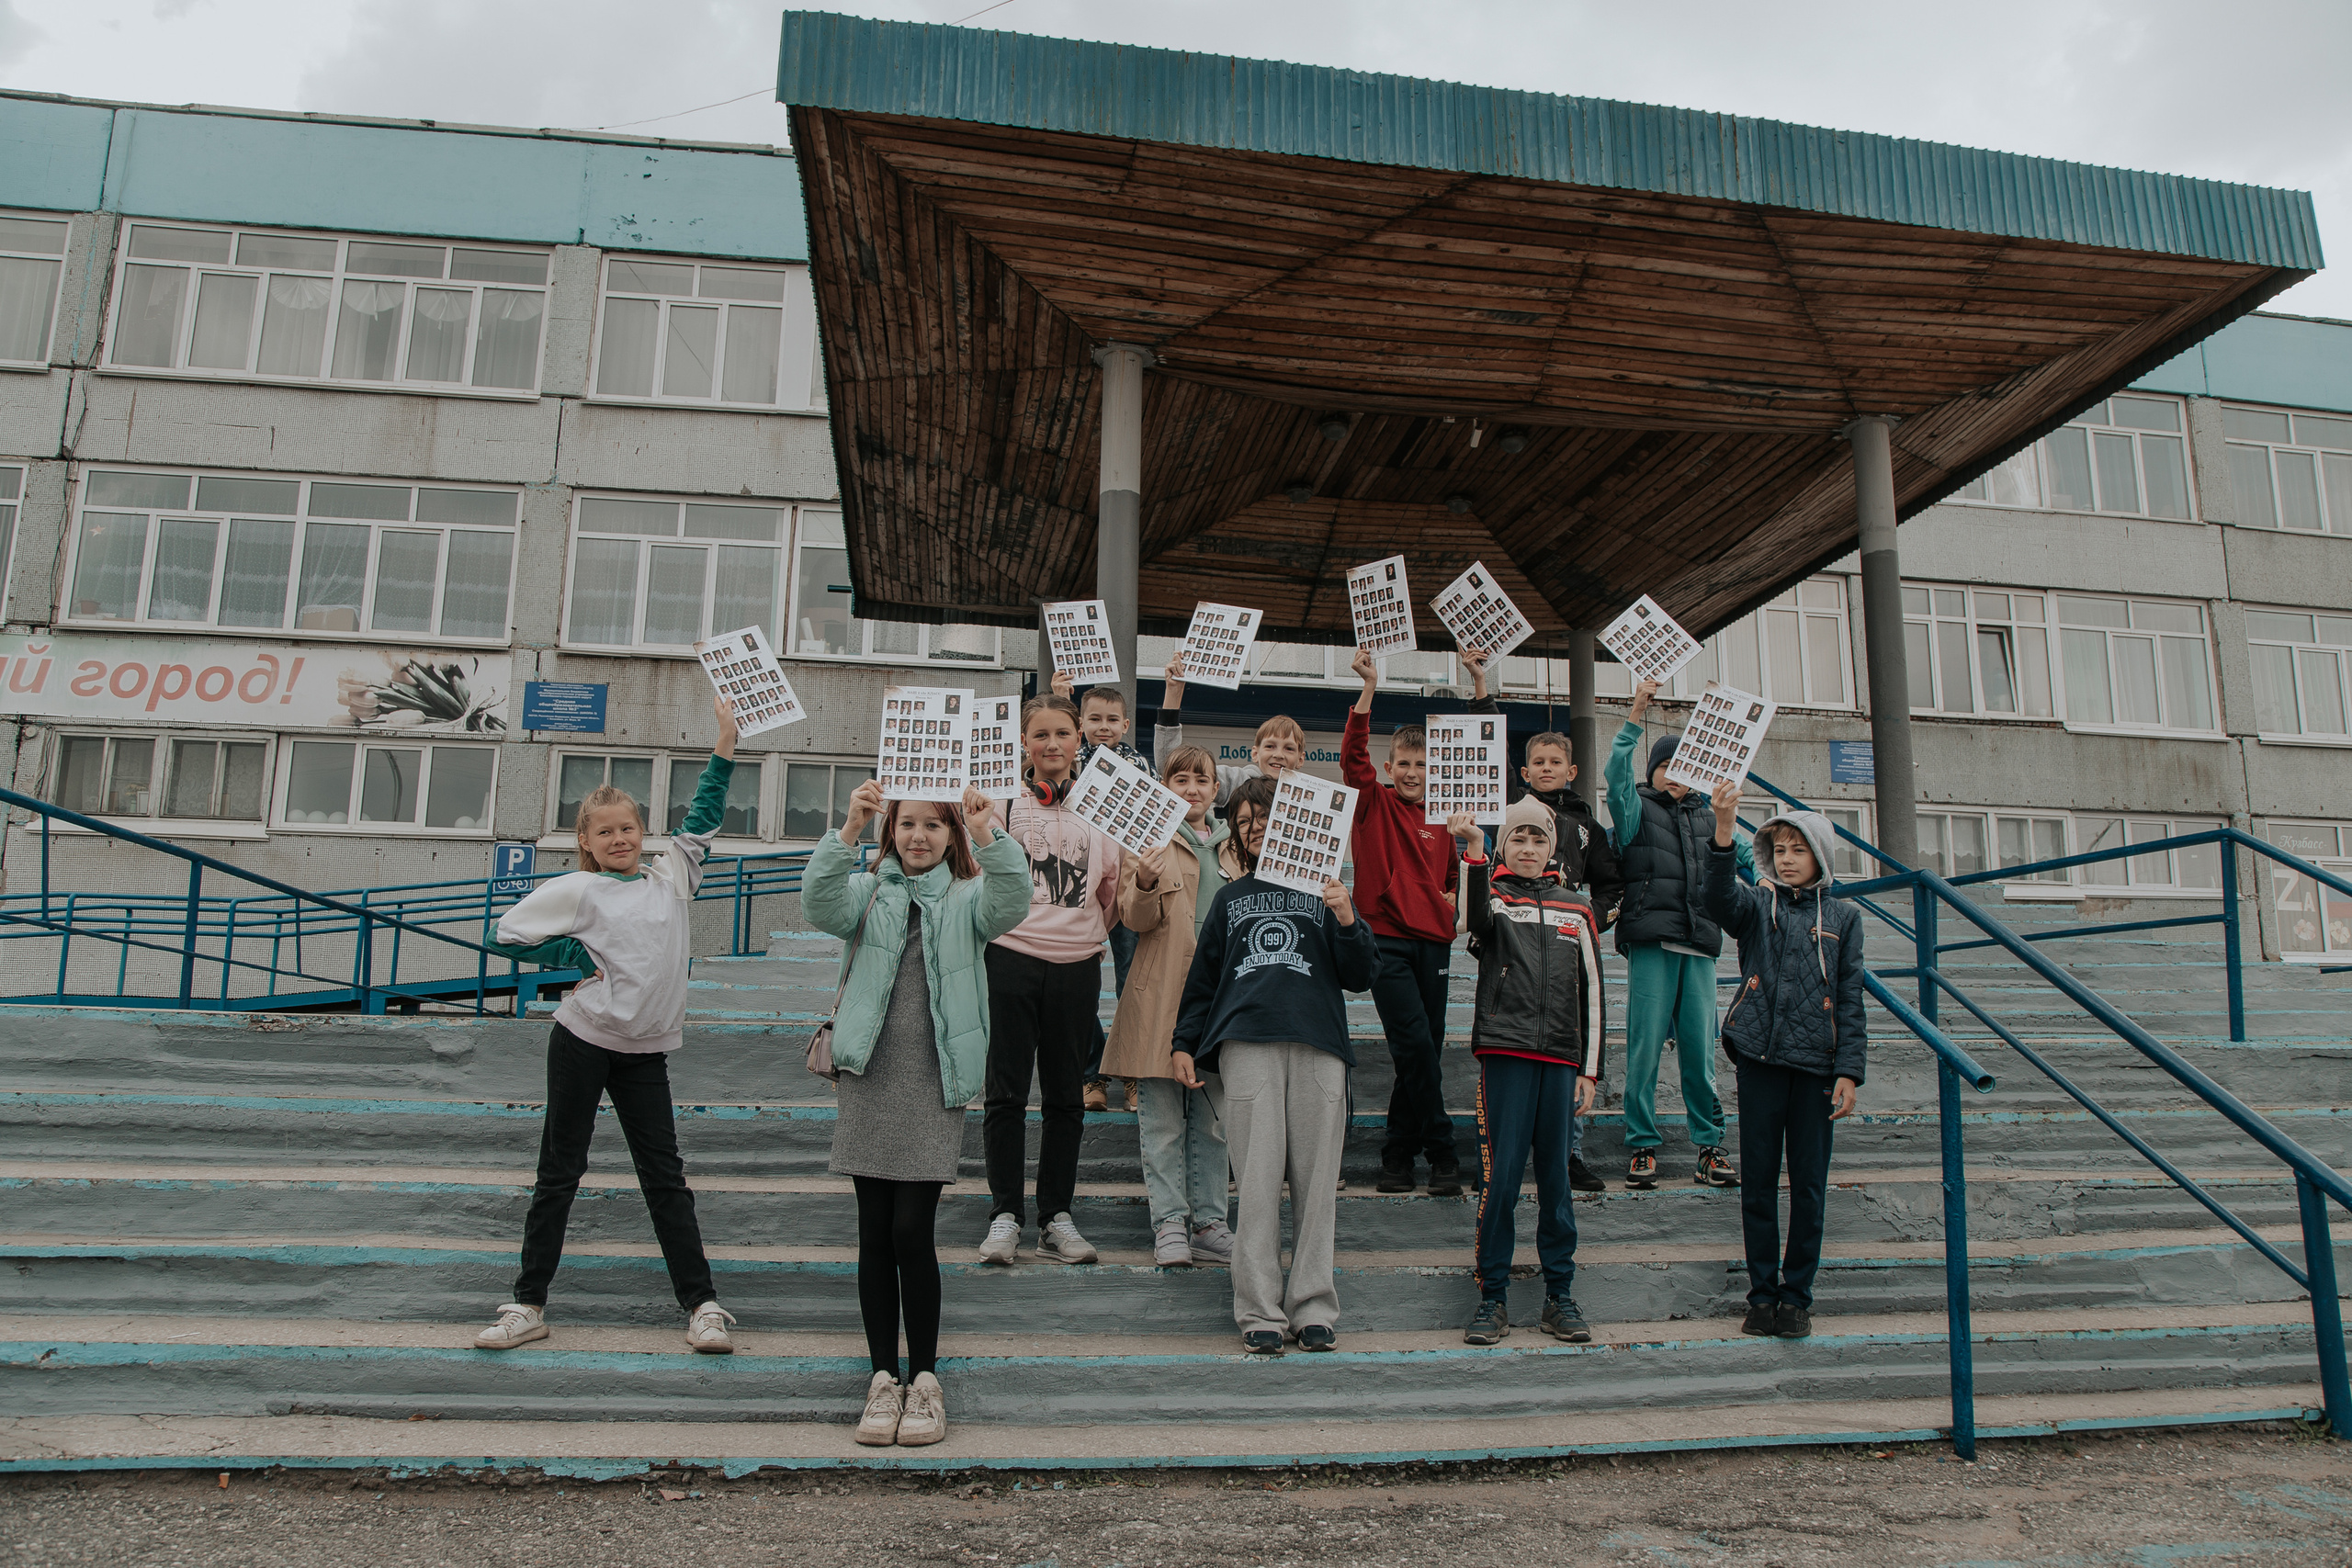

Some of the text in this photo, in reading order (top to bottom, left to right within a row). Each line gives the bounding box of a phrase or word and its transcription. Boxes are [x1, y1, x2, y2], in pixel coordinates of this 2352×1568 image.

[70, 653, 306, 712] город!
[1219, 745, 1252, 761] Добр
[508, 848, 526, 871] P
[1227, 891, 1284, 936] FEELING
[1263, 932, 1283, 946] 1991
[1245, 953, 1302, 967] ENJOY TODAY
[1480, 1143, 1491, 1182] MESSI
[1477, 1187, 1488, 1219] NETO
